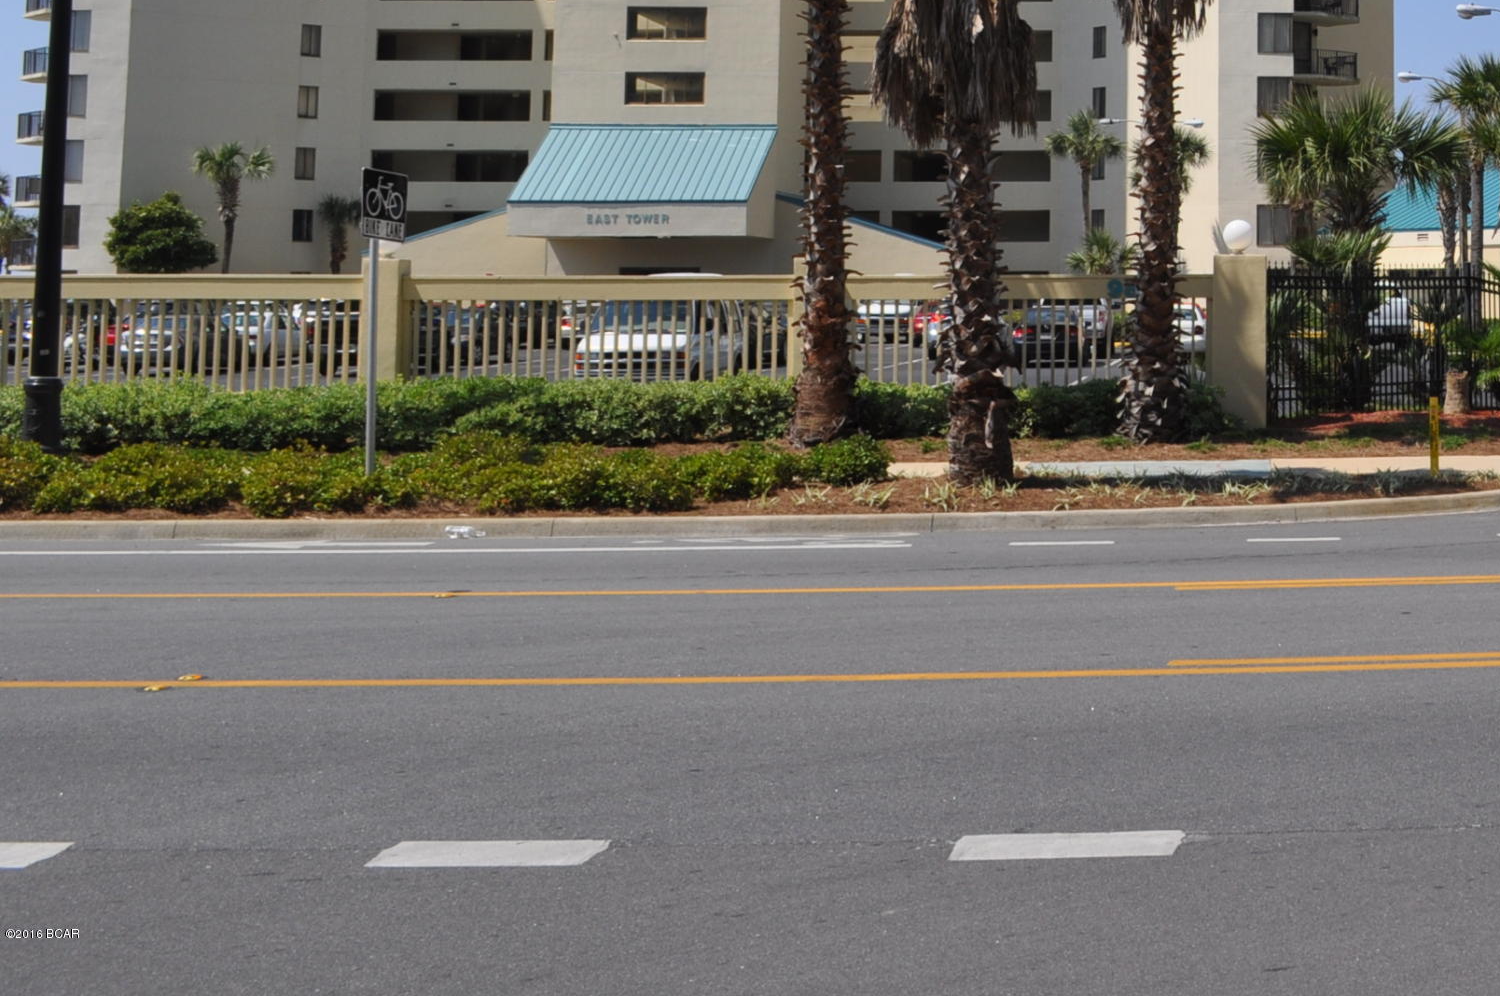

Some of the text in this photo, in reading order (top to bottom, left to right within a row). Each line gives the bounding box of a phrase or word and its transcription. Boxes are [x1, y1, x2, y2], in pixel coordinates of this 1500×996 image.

[586, 213, 670, 225] EAST TOWER
[365, 218, 403, 240] BIKE LANE
